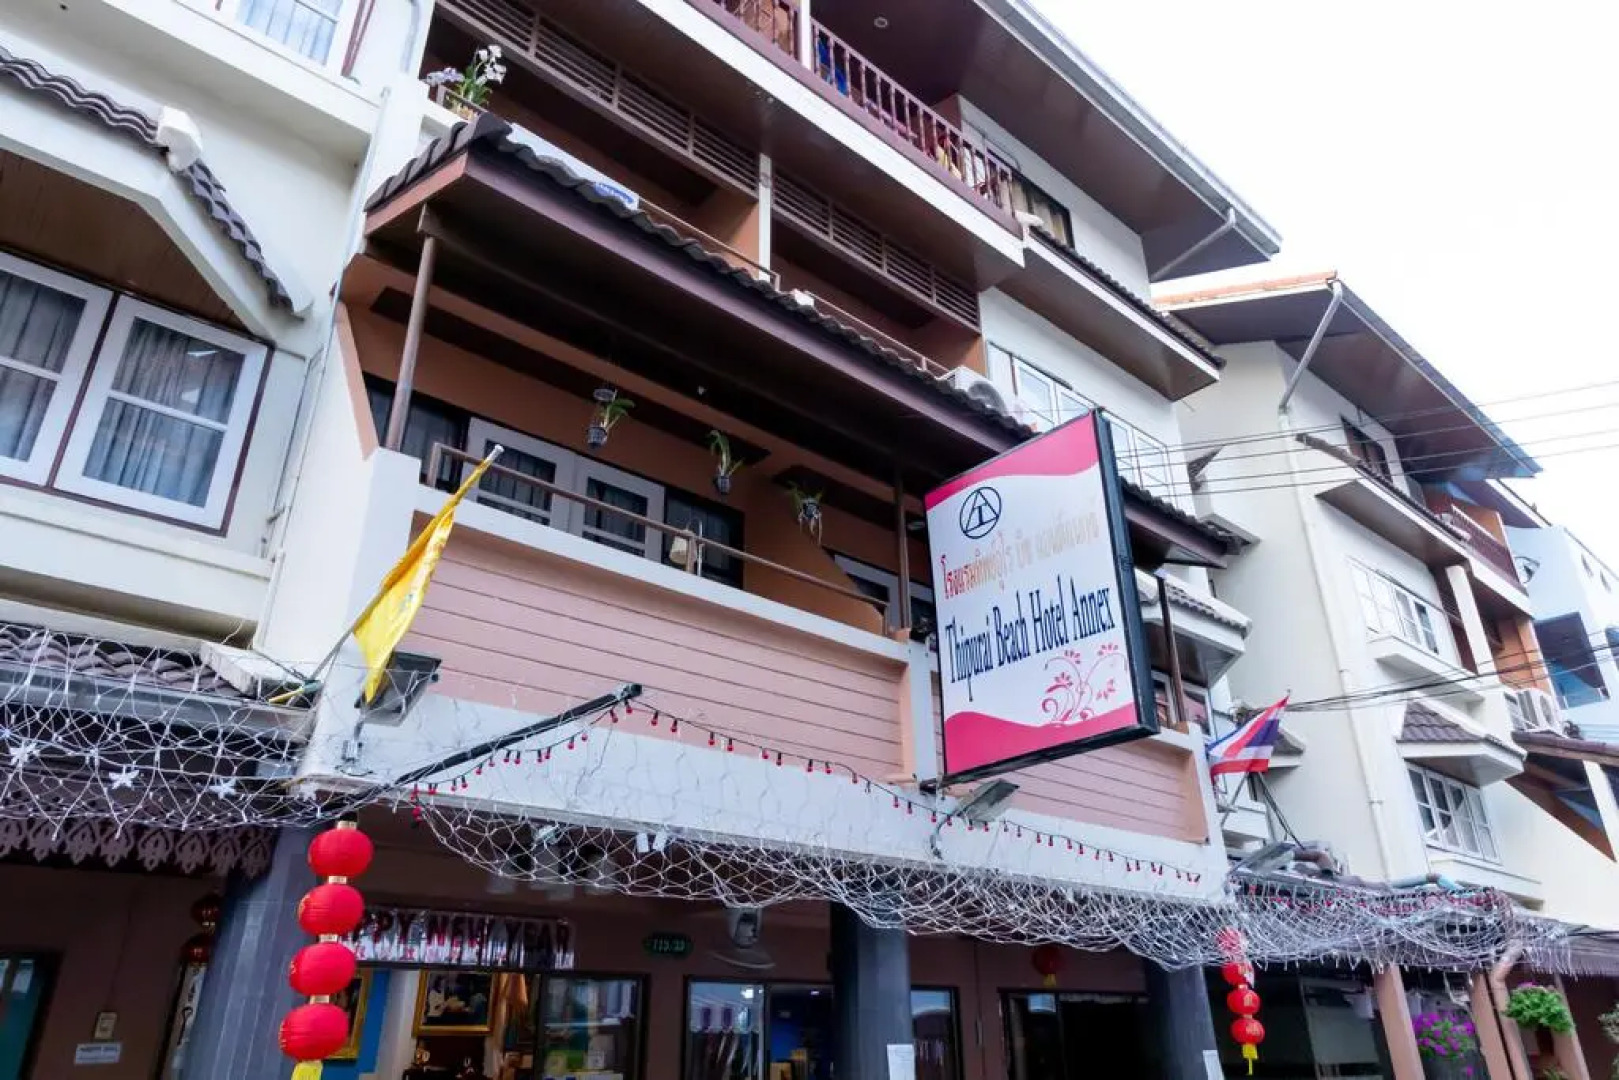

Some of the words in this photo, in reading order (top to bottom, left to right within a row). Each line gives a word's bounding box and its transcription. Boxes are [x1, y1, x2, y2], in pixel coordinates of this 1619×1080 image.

[945, 614, 994, 702] Thipurai
[993, 590, 1031, 667] Beach
[1029, 573, 1070, 653] Hotel
[1070, 575, 1116, 641] Annex
[426, 910, 498, 950] NEW
[503, 917, 572, 955] YEAR
